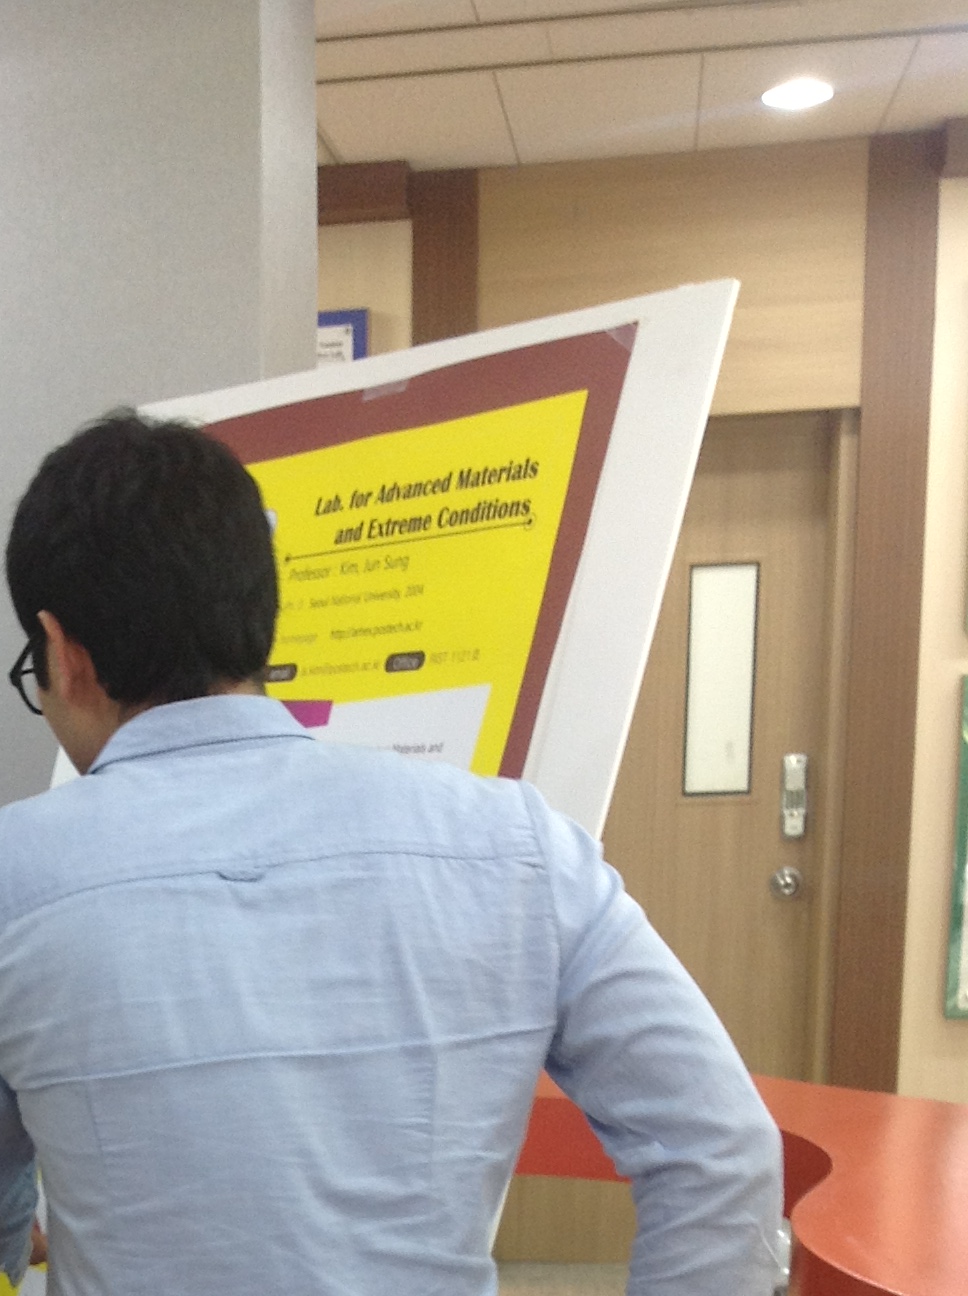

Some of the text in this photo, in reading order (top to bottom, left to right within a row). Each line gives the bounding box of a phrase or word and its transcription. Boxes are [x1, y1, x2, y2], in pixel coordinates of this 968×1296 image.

[314, 457, 540, 516] Lab. for Advanced Materials
[334, 498, 532, 545] and Extreme Conditions
